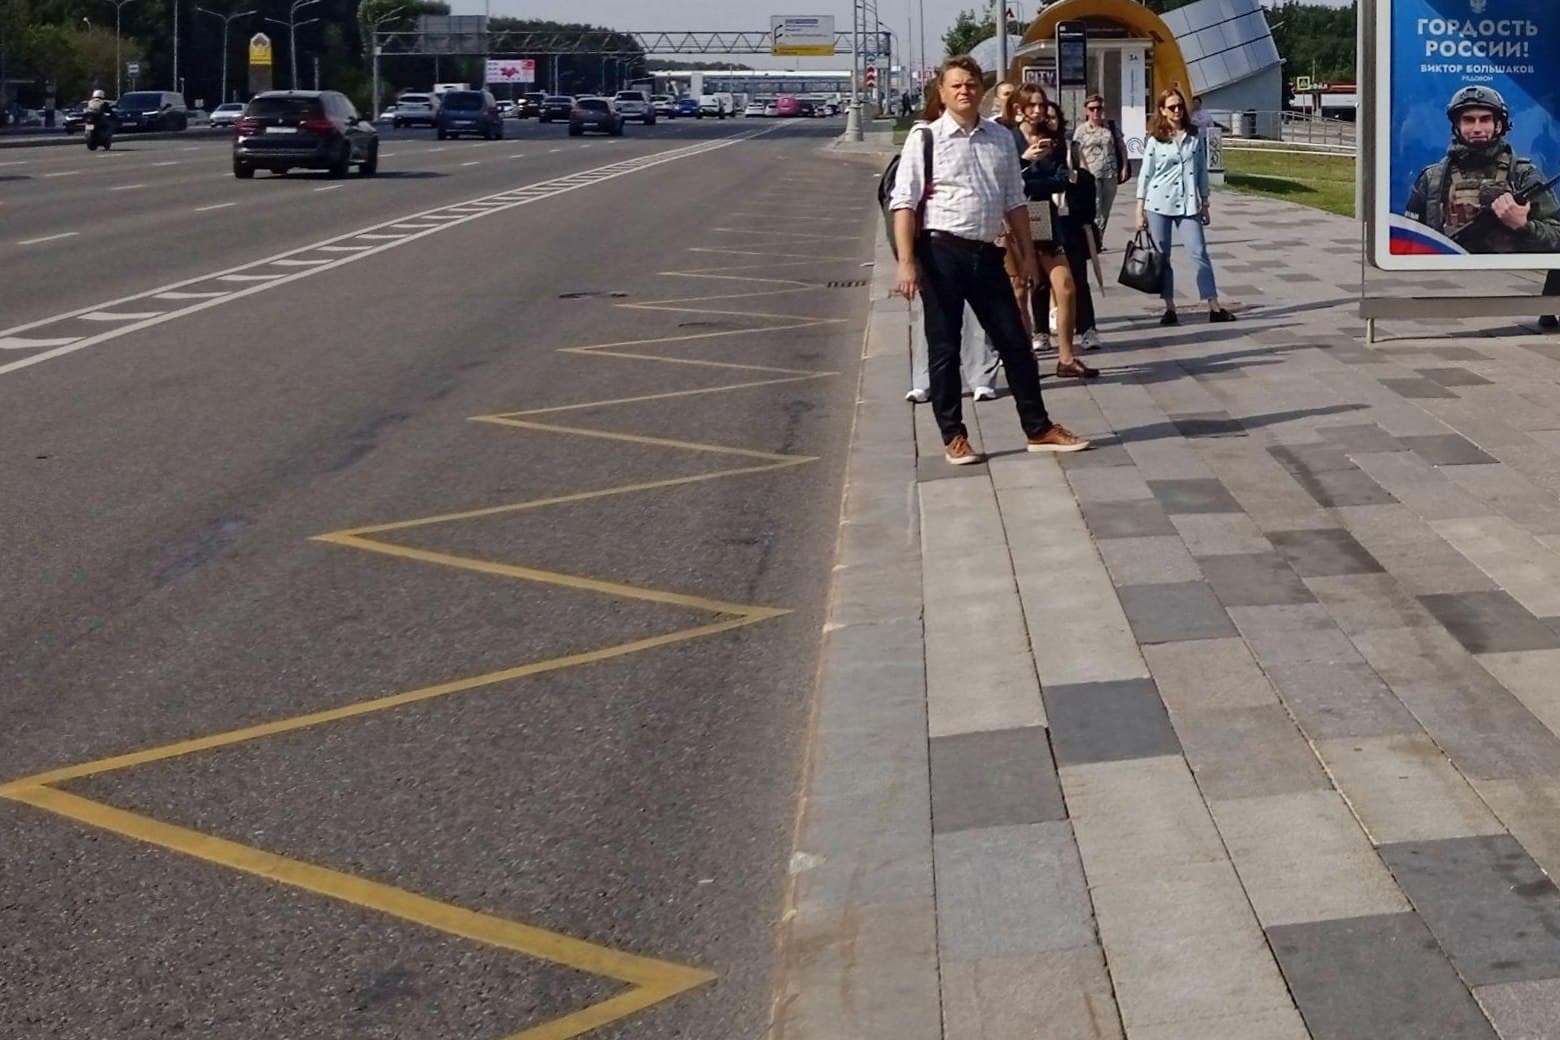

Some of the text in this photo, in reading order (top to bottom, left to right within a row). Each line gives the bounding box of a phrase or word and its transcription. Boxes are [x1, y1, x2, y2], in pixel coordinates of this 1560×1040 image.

[1417, 18, 1539, 38] ГОРДОСТЬ
[1425, 40, 1529, 57] РОССИИ!
[1420, 63, 1535, 74] ВИКТОР БОЛЬШАКОВ
